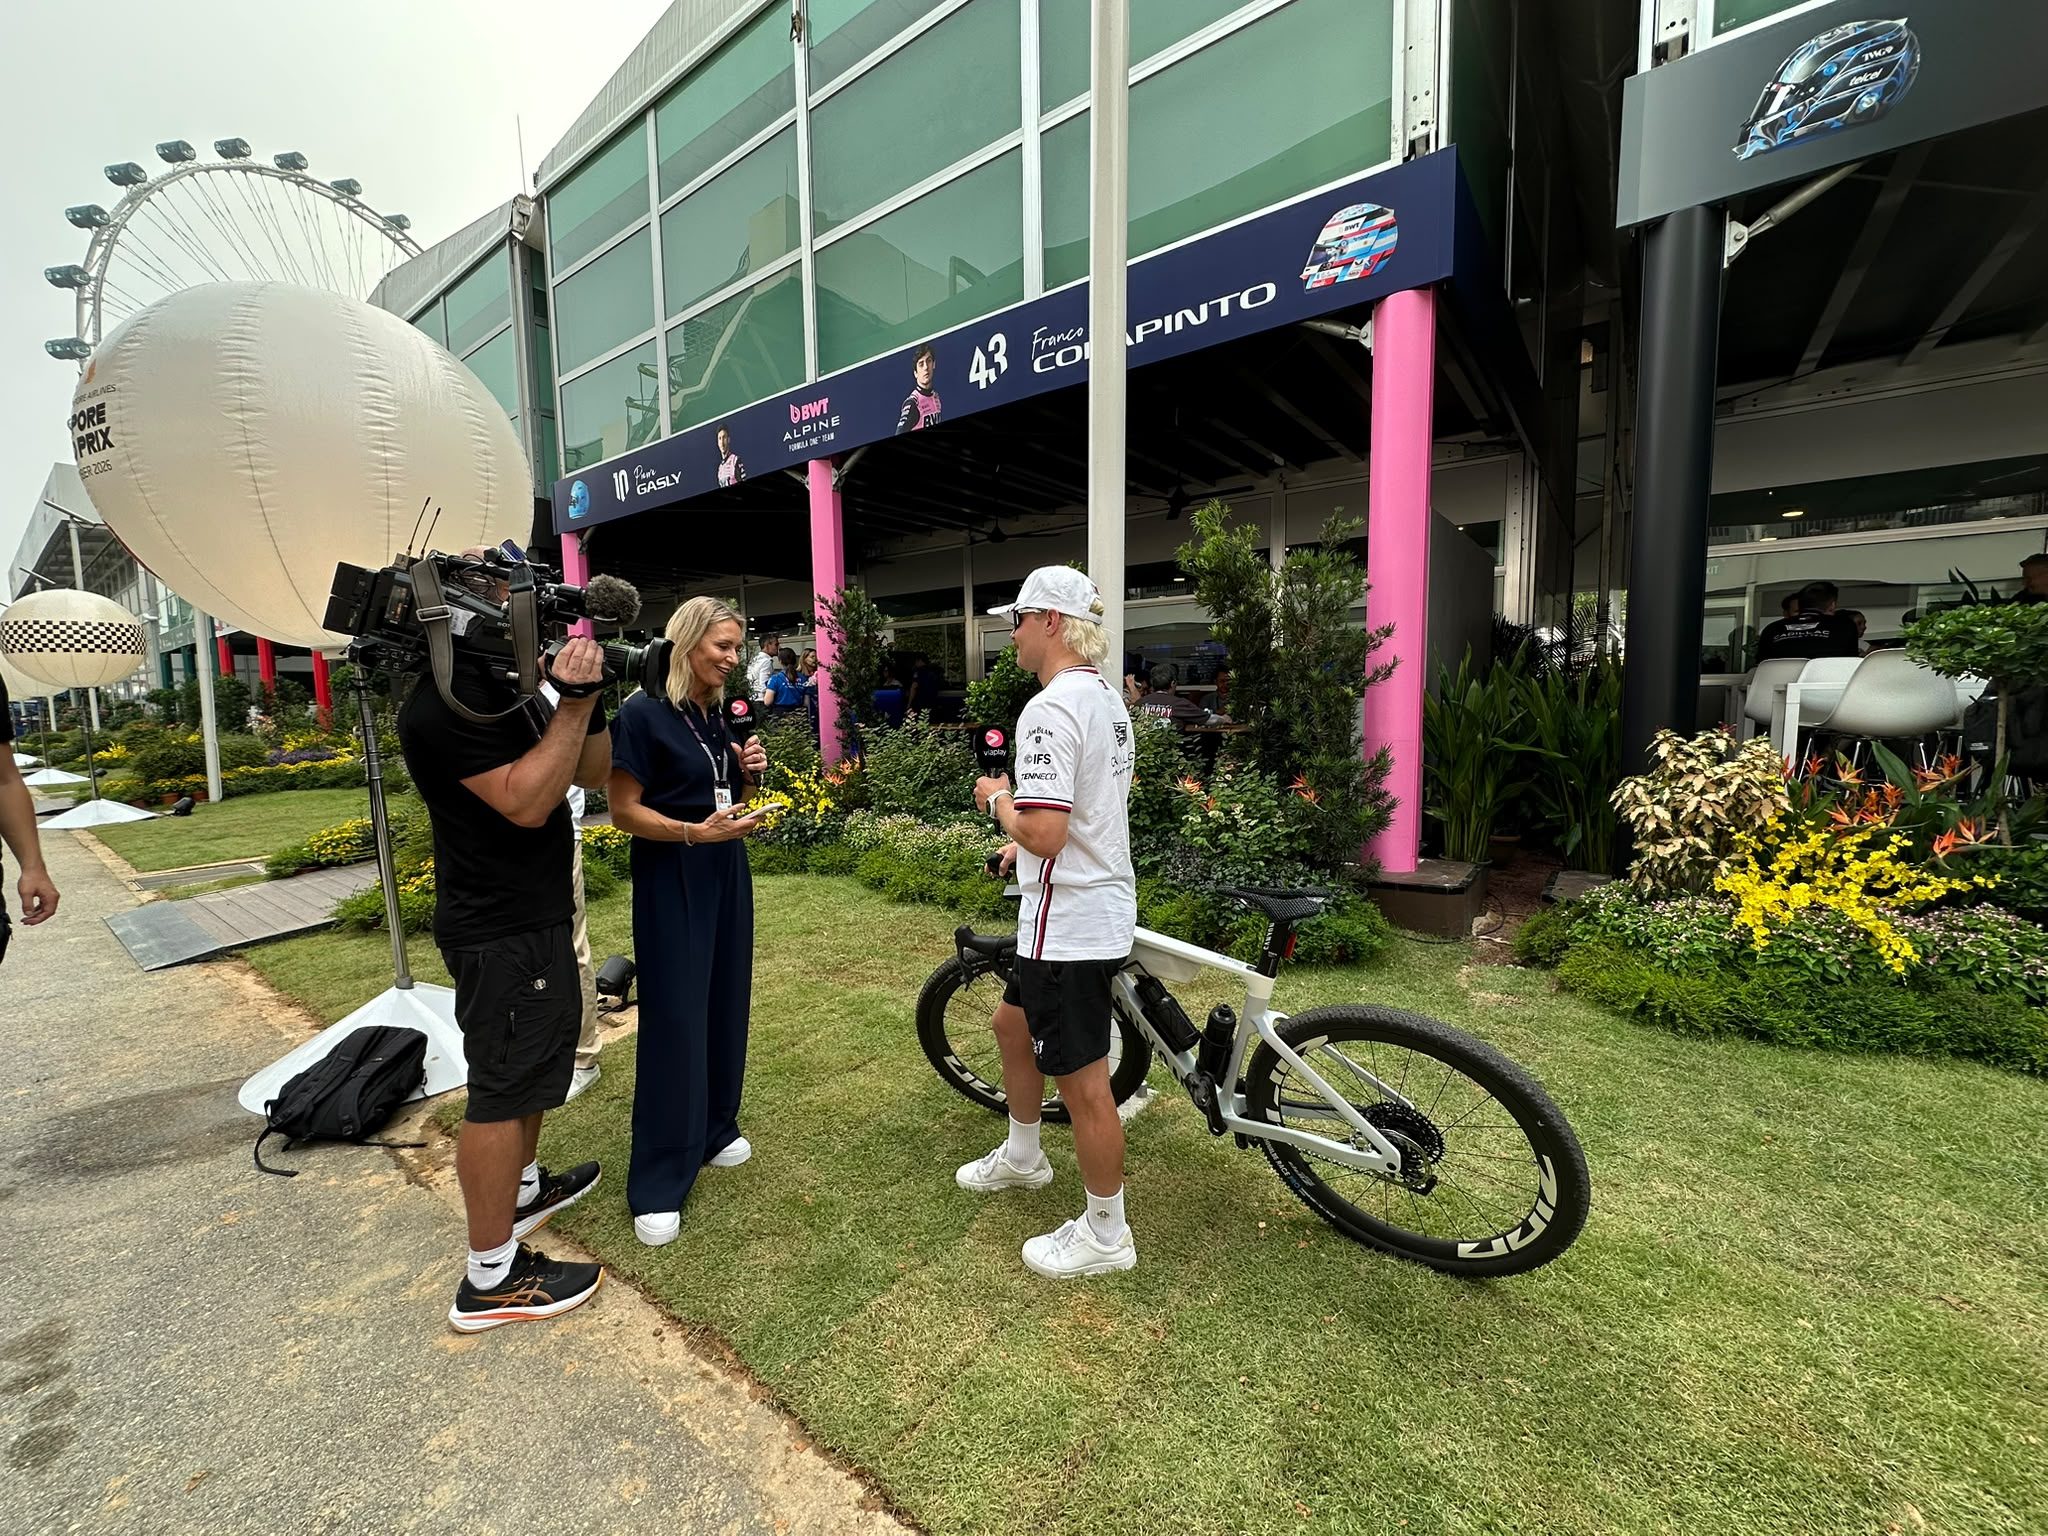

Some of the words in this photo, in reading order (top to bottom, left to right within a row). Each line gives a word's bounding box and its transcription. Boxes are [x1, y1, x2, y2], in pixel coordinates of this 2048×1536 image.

[1849, 68, 1883, 86] telcel
[1033, 282, 1277, 374] COPINTO
[1031, 326, 1084, 360] Franco
[968, 333, 1008, 390] 43
[801, 398, 829, 421] BWT
[782, 415, 840, 442] ALPINE
[77, 426, 116, 458] PRIX
[788, 440, 808, 452] FORMULA
[822, 432, 835, 442] TEAM
[92, 459, 112, 474] 2026
[612, 469, 630, 502] 10
[636, 471, 682, 496] GASLY
[731, 716, 753, 724] viaplay
[1033, 754, 1051, 765] IFS
[1021, 772, 1057, 781] TENNECO
[1263, 922, 1275, 950] CANYON
